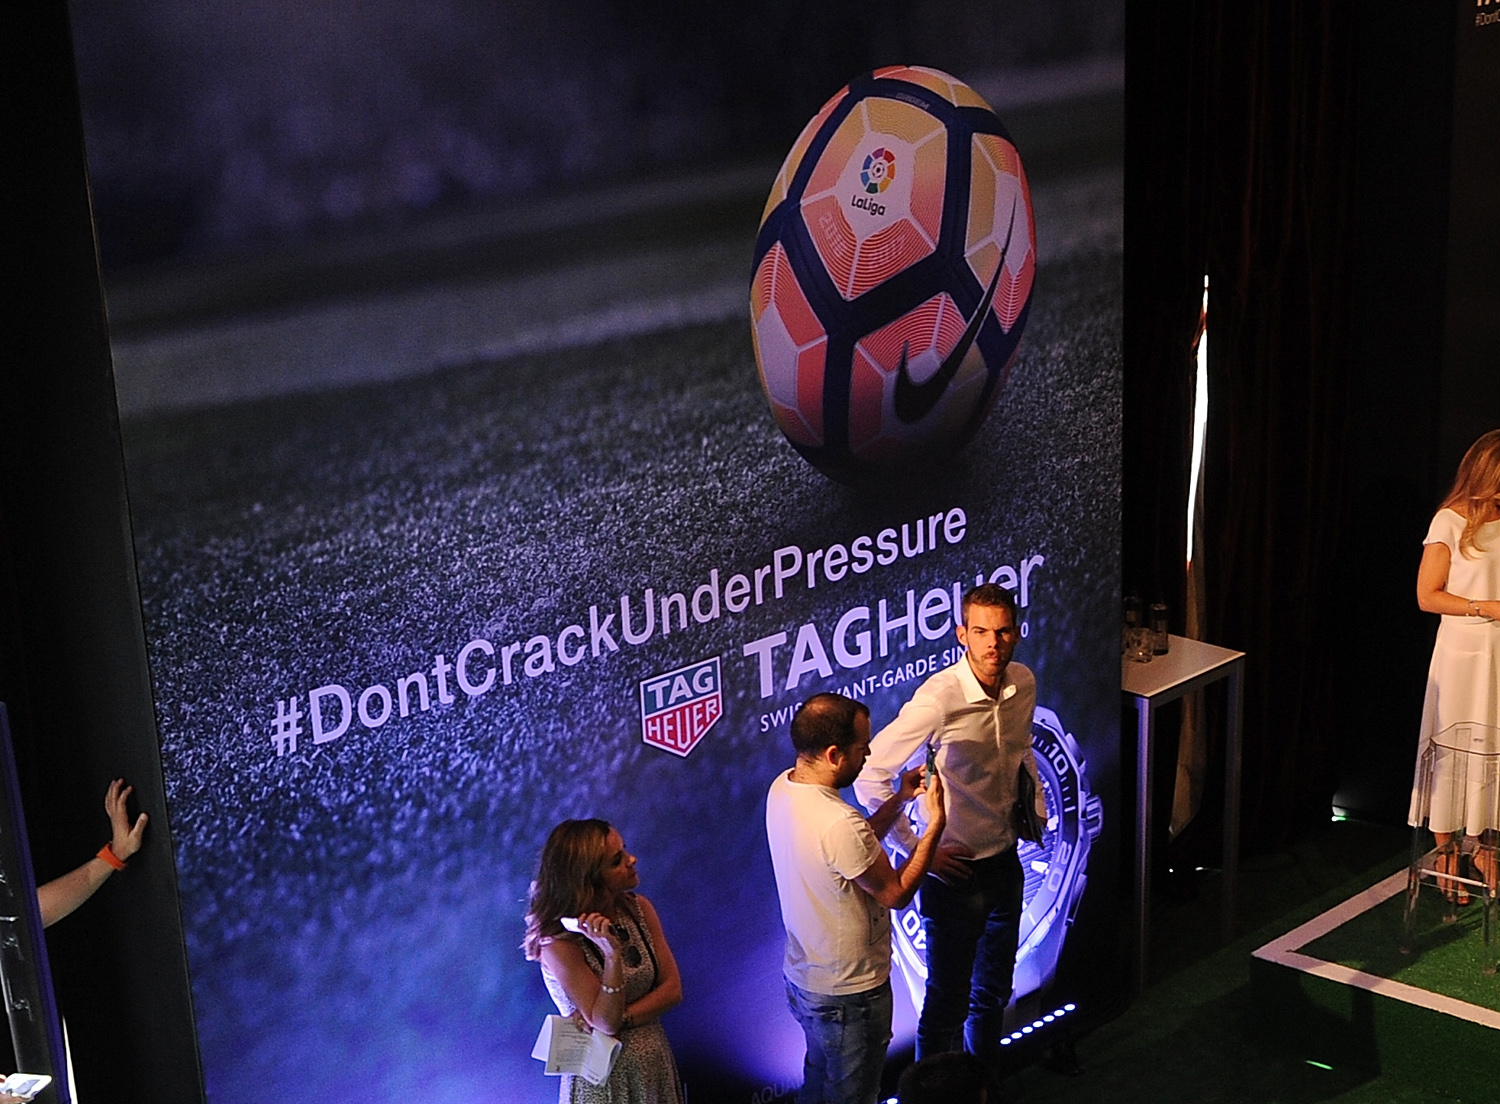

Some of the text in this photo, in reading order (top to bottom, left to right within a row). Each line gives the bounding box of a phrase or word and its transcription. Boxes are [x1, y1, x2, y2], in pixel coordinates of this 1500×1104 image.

[850, 193, 886, 216] LaLiga
[270, 507, 968, 757] #DontCrackUnderPressure
[647, 665, 714, 709] TAG
[646, 697, 719, 755] HEUER
[1048, 742, 1067, 776] 10
